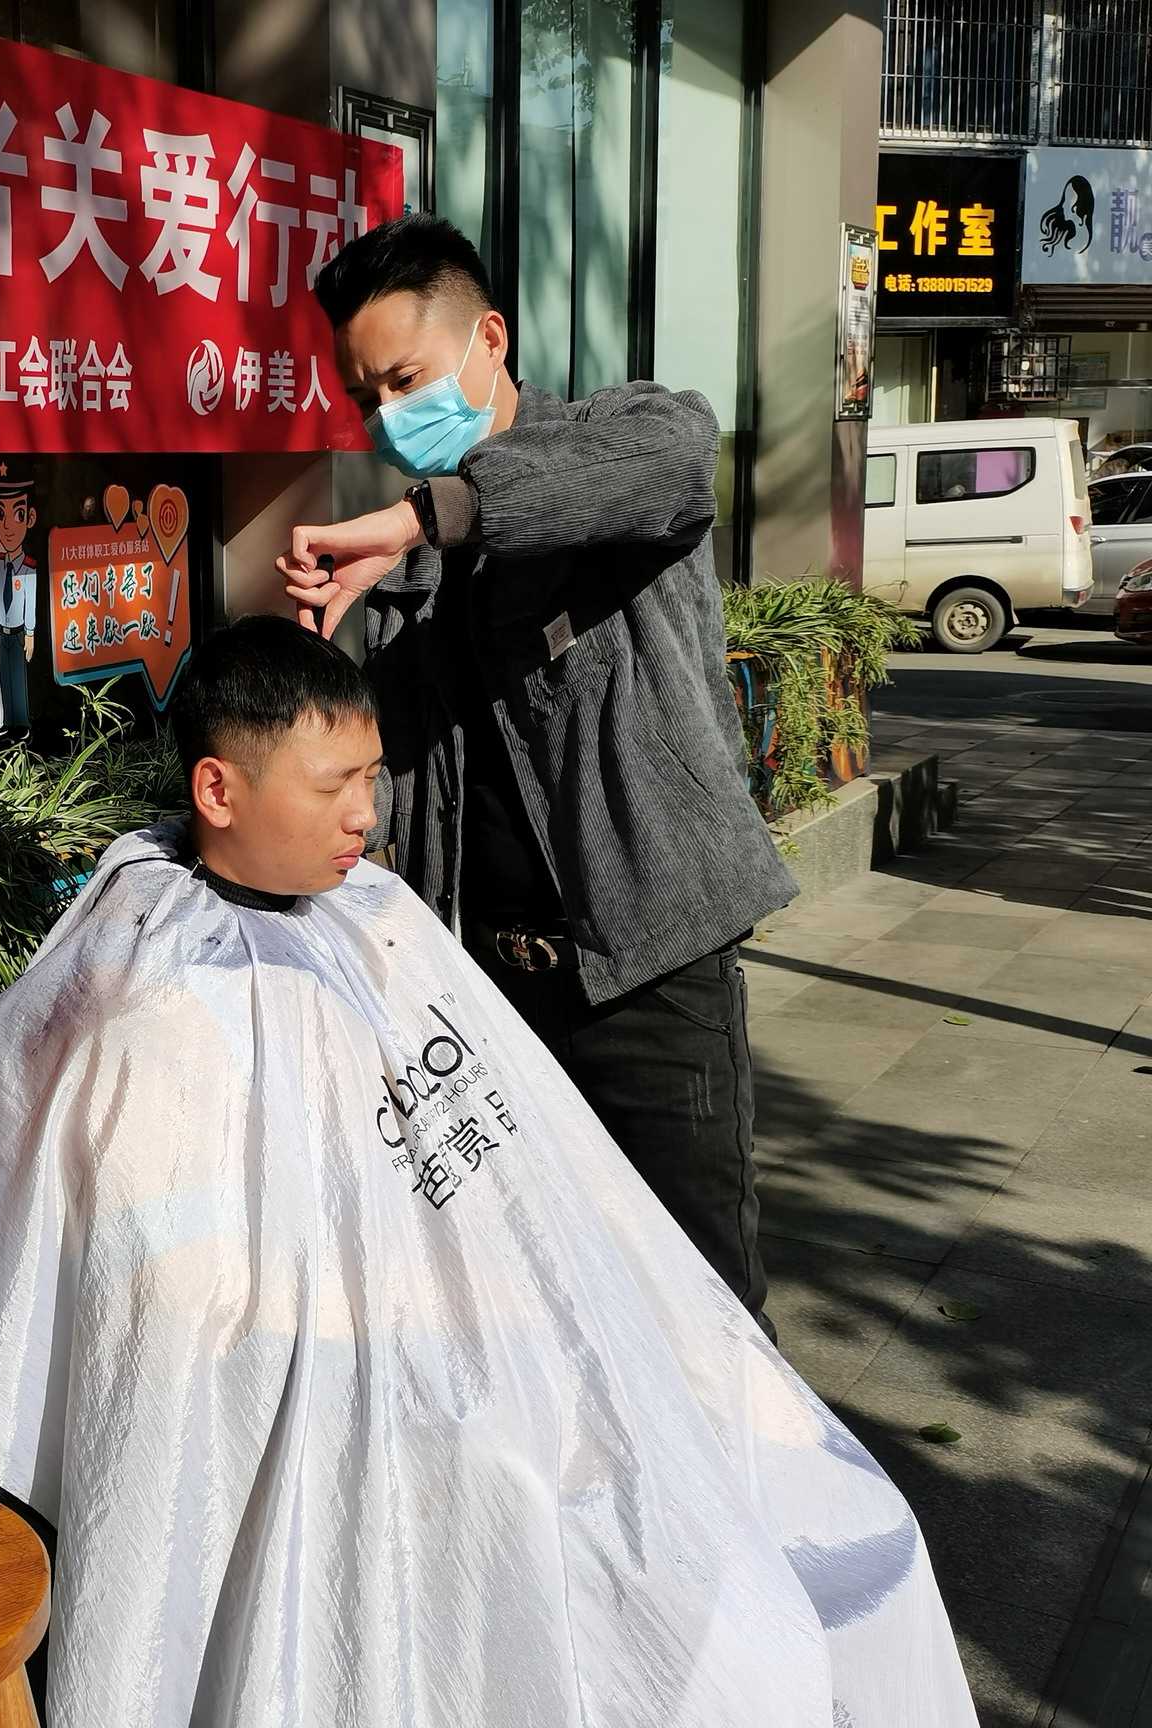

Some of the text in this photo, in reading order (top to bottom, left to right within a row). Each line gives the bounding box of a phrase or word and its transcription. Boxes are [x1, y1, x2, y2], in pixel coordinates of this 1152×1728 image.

[876, 200, 995, 256] 工作室
[232, 346, 331, 413] 伊美人
[444, 1062, 489, 1105] HOURS
